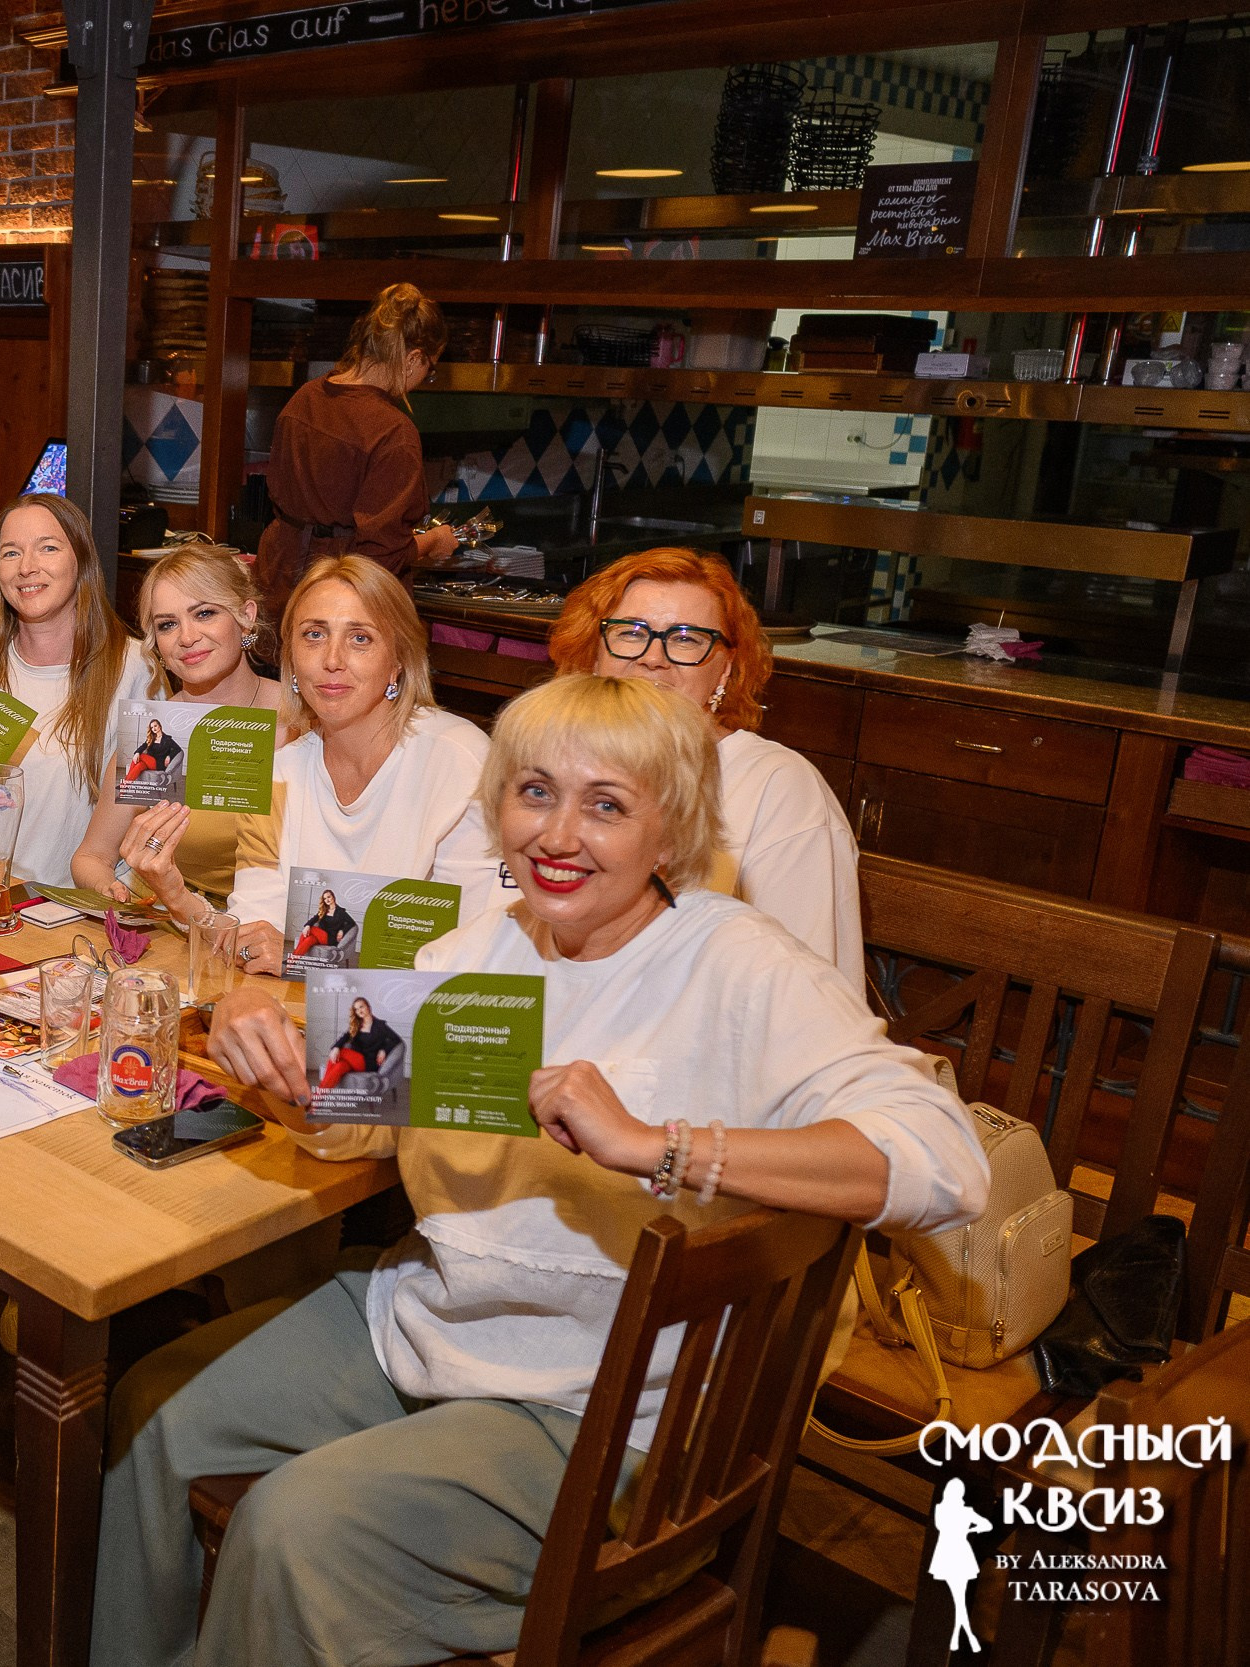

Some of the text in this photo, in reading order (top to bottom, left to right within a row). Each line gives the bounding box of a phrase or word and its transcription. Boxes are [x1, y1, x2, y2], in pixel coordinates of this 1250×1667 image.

[150, 36, 192, 62] das
[208, 25, 270, 53] Glas
[291, 6, 350, 39] auf
[878, 194, 947, 210] команды
[896, 216, 961, 230] пивоварни
[867, 229, 946, 248] Max Bräu
[211, 739, 253, 748] Подарочный
[211, 746, 252, 754] Сертификат
[388, 914, 434, 926] Подарочный
[388, 922, 433, 933] Сертификат
[444, 1023, 511, 1036] Подарочный
[445, 1032, 509, 1045] Сертификат
